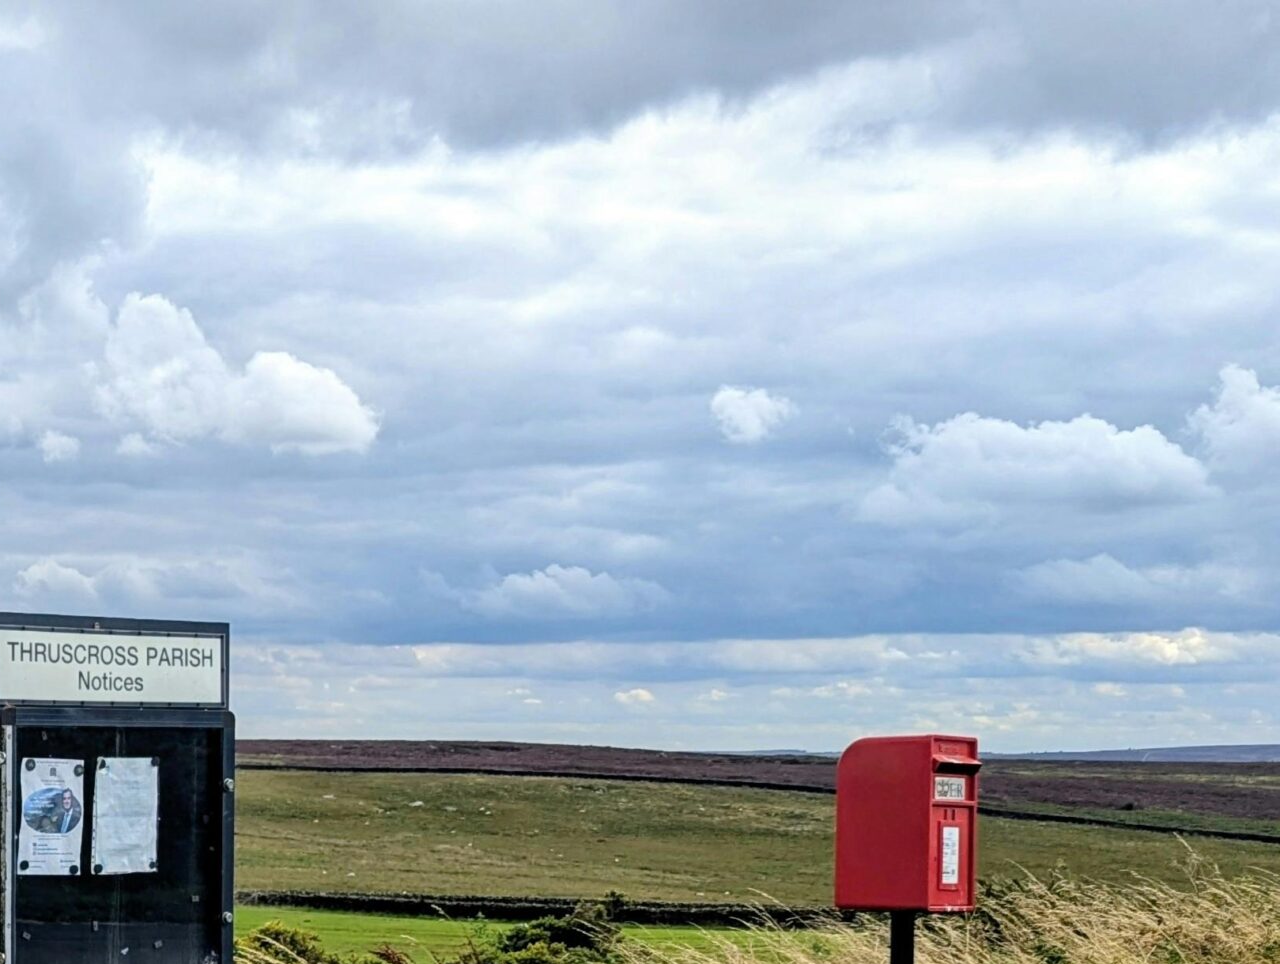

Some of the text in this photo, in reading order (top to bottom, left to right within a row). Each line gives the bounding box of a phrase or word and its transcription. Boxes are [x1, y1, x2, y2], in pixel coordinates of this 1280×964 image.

[7, 641, 213, 668] THRUSCROSS PARISH
[78, 671, 144, 692] Notices
